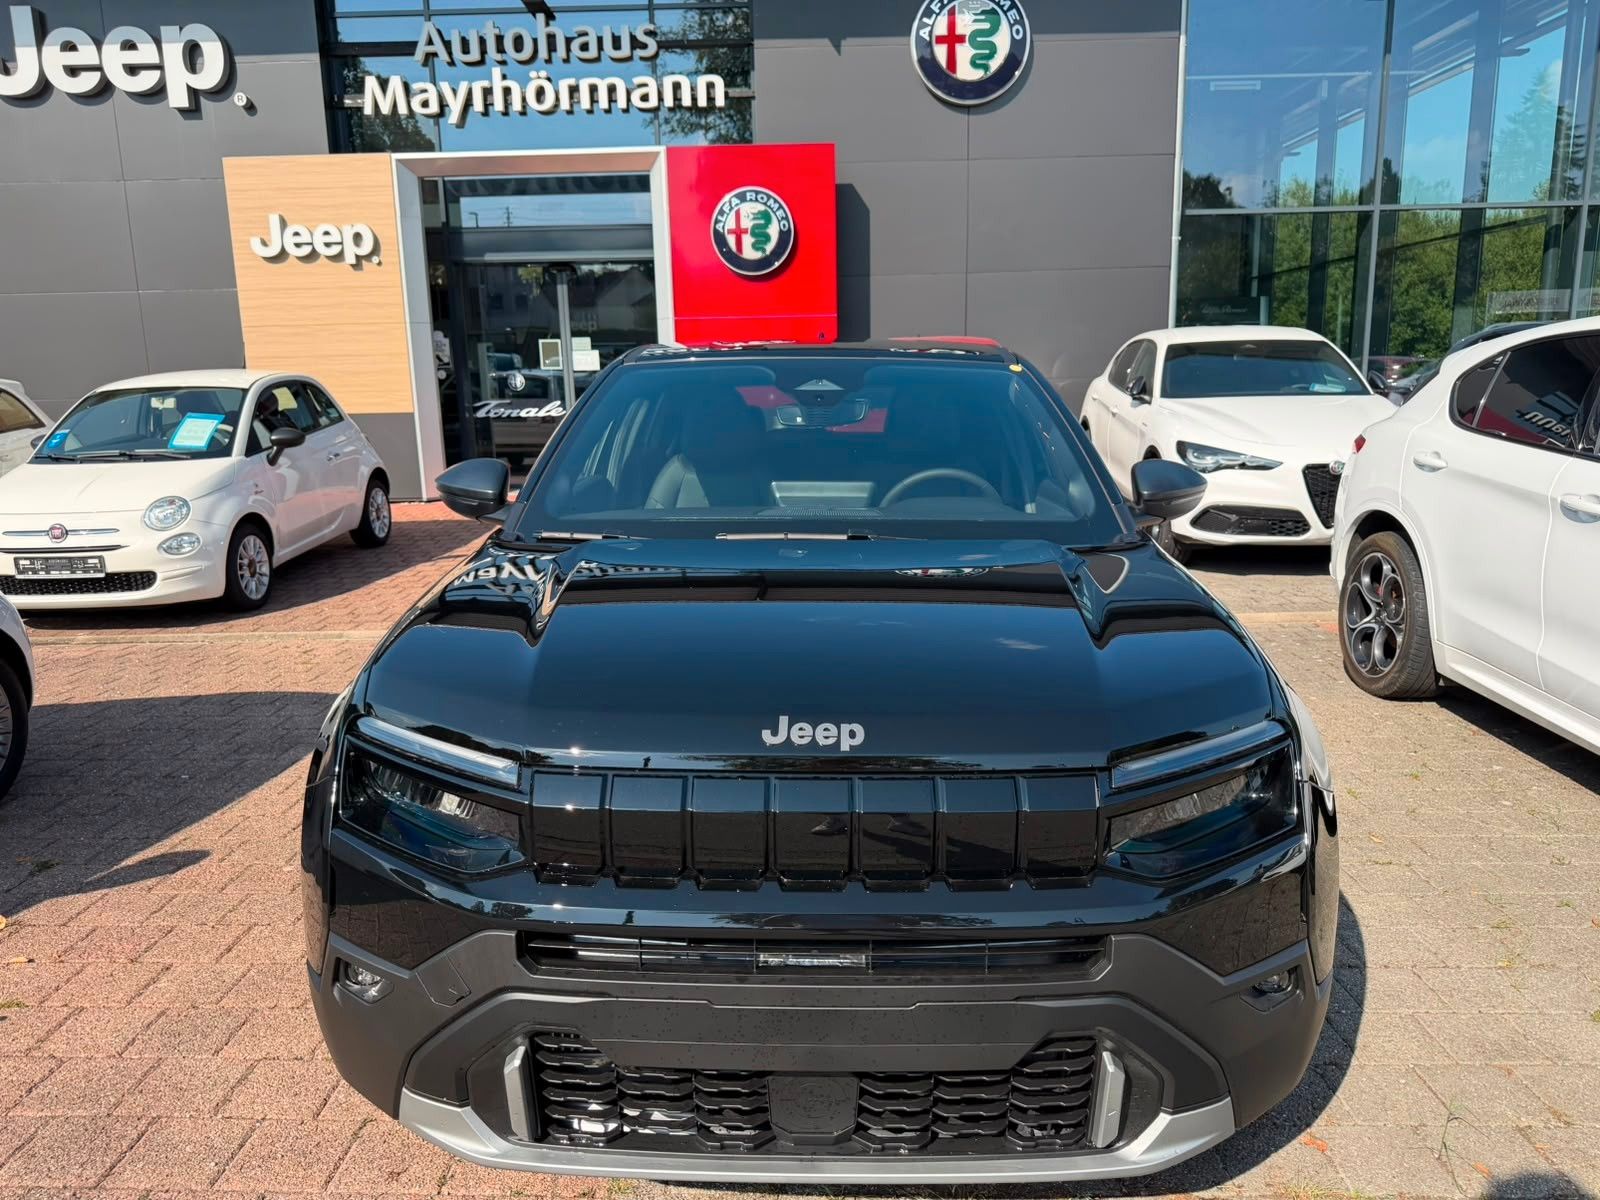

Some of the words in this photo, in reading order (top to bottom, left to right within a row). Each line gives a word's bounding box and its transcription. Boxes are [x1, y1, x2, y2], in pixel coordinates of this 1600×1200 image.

[414, 13, 659, 64] Autohaus
[919, 0, 949, 41] ALF
[0, 5, 225, 108] Jeep
[363, 67, 725, 124] Mayrhörmann
[715, 197, 741, 233] ALFA
[745, 191, 789, 232] ROMEO
[249, 213, 375, 265] Jeep
[472, 400, 567, 419] Tonale
[761, 715, 865, 752] Jeep
